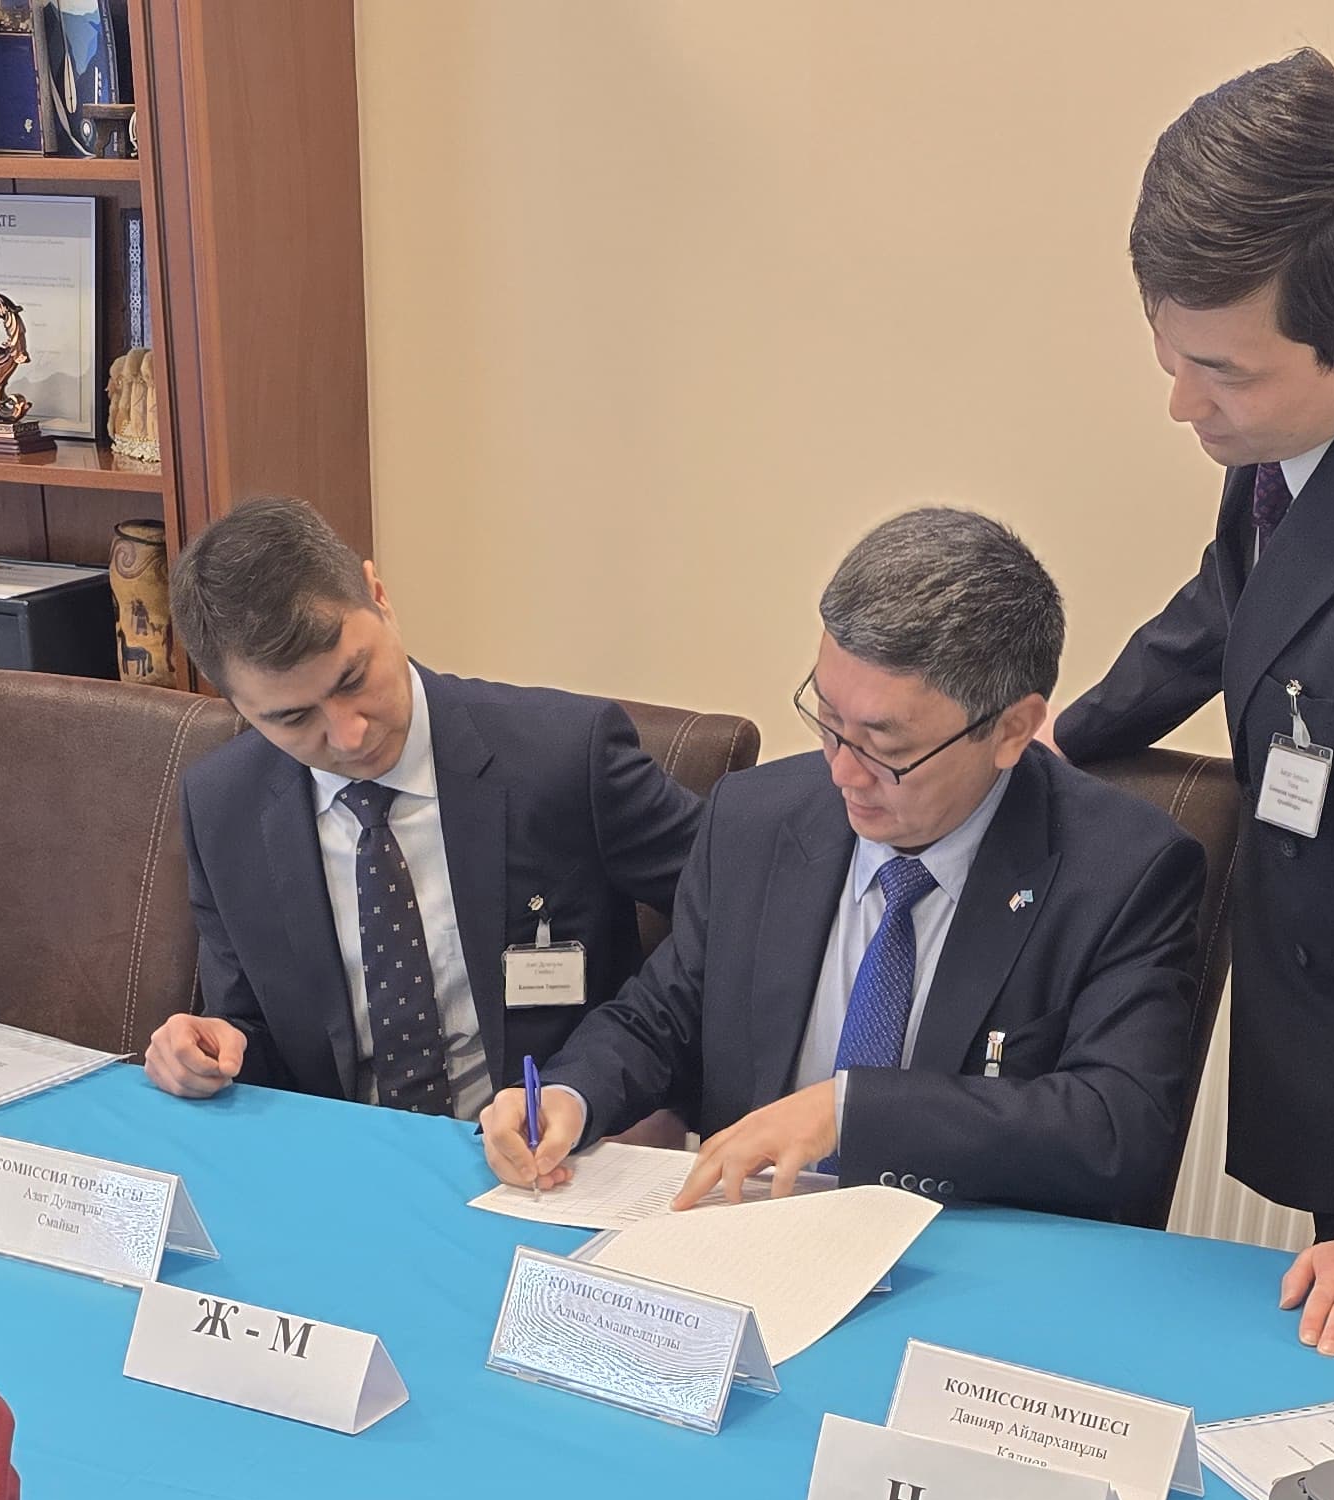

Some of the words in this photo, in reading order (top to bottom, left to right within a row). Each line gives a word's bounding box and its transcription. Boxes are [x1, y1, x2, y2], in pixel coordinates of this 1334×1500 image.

[22, 1187, 48, 1203] Азат
[37, 1213, 80, 1234] Смайыл
[548, 1276, 633, 1311] КОМИССИЯ
[635, 1300, 701, 1330] МҮШЕСІ
[553, 1303, 591, 1324] Алмас
[191, 1298, 240, 1341] Ж
[245, 1328, 260, 1338] -
[268, 1315, 317, 1360] М
[944, 1377, 1047, 1417] КОМИССИЯ
[1050, 1404, 1131, 1438] МҮШЕСІ
[950, 1407, 1004, 1435] Данияр
